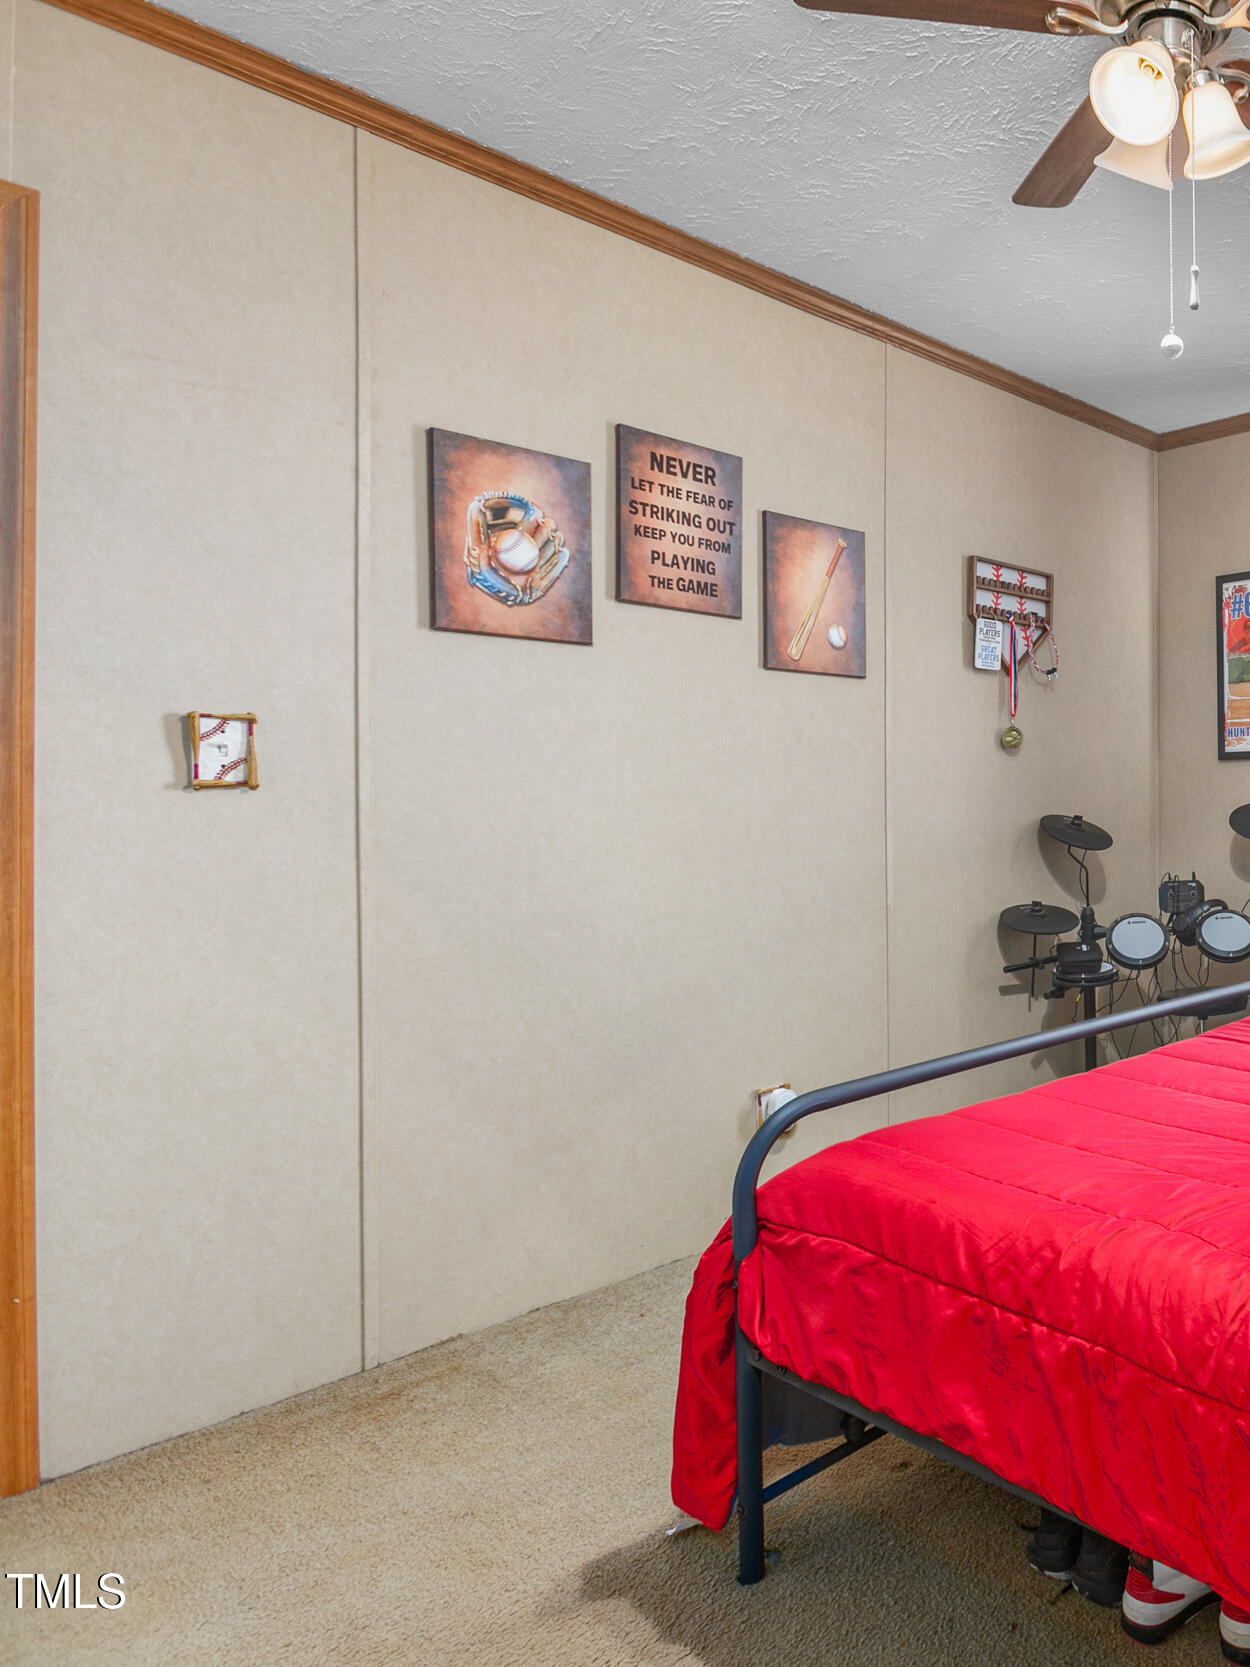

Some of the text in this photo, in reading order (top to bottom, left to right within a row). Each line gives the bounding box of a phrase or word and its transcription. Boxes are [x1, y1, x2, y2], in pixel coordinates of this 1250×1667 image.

[650, 451, 717, 486] NEVER
[631, 477, 734, 511] LET THE FEAR OF
[629, 500, 736, 536] STRIKING OUT
[634, 523, 731, 555] KEEP YOU FROM
[651, 549, 716, 576] PLAYING
[649, 574, 718, 598] THE GAME
[979, 628, 1000, 638] PLAYERS
[978, 652, 1000, 662] PLAYERS
